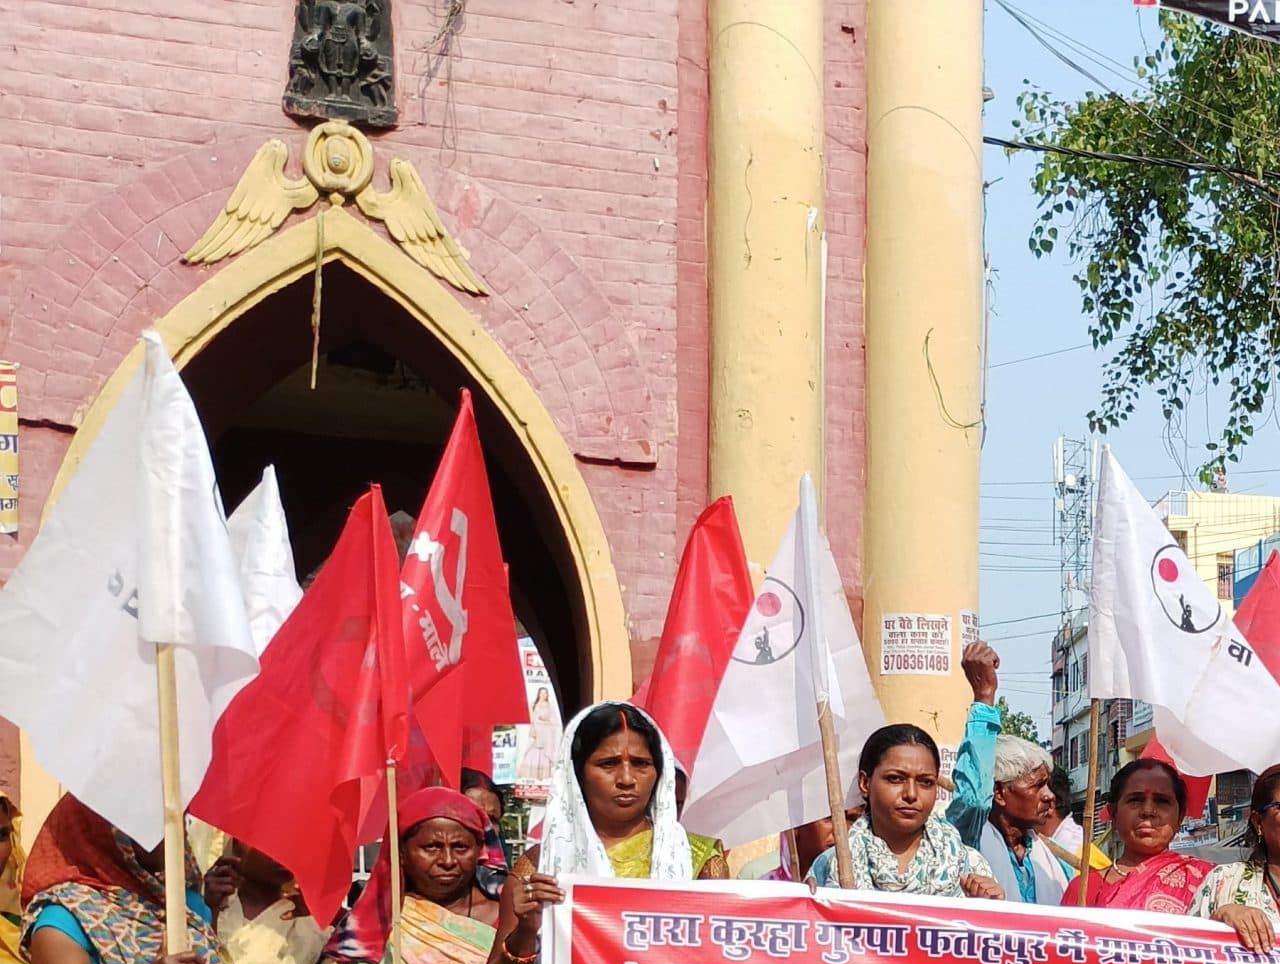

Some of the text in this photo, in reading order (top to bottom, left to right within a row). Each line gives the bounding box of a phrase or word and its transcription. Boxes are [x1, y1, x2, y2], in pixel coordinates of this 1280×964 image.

[883, 654, 949, 671] 9708361489
[622, 911, 703, 949] हारा
[708, 914, 809, 958] कुरहा
[815, 920, 912, 964] गुरपा
[1056, 930, 1087, 963] में
